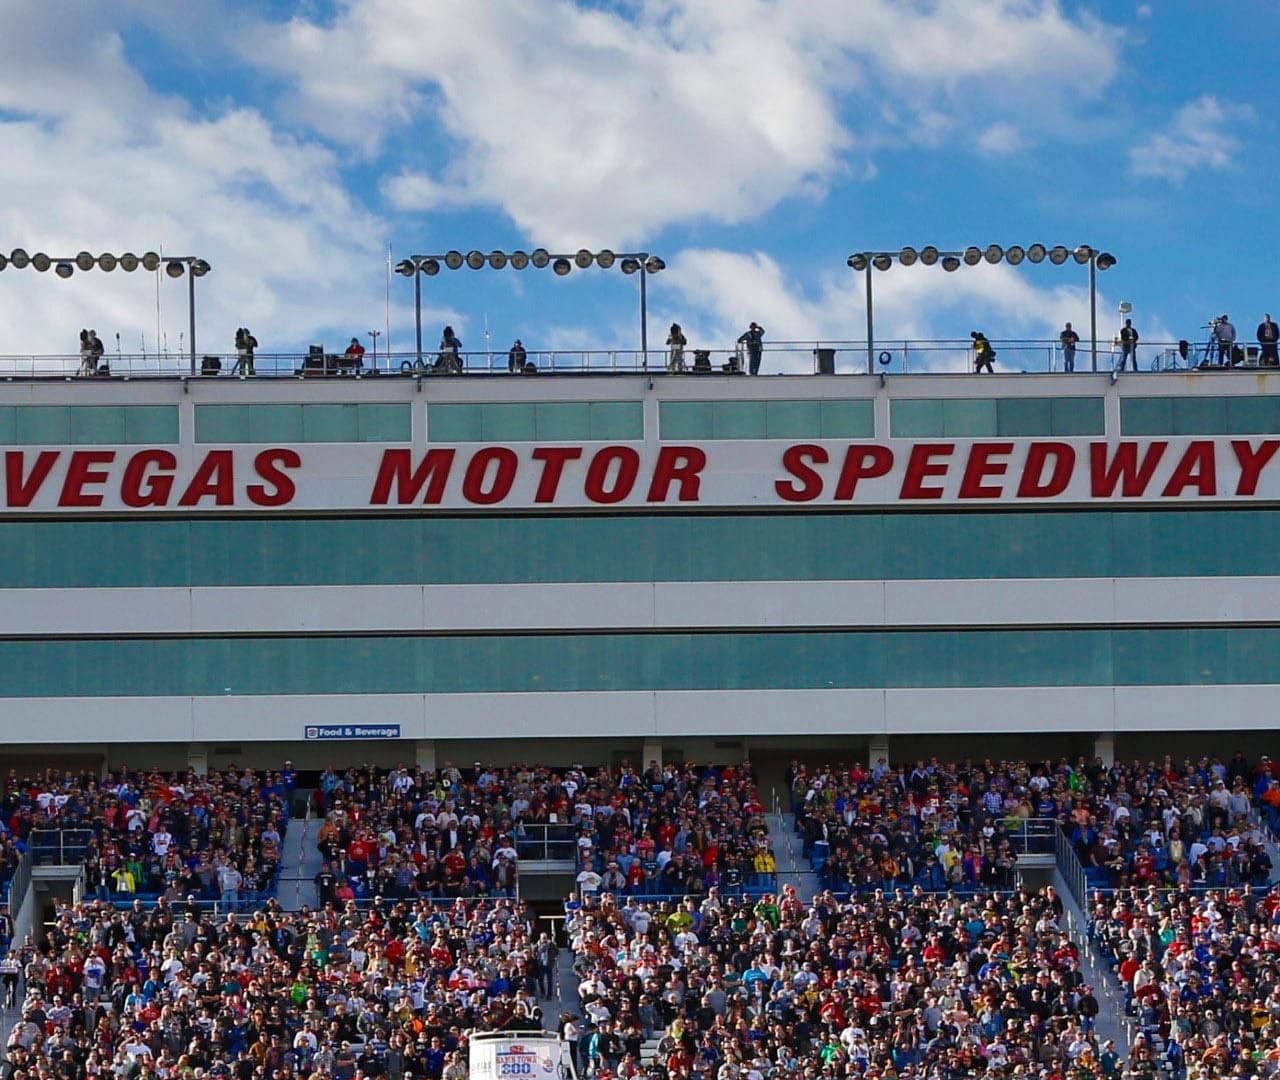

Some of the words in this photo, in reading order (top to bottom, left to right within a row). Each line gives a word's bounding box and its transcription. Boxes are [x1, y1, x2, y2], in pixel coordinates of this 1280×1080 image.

[5, 448, 302, 507] VEGAS
[369, 446, 707, 505] MOTOR
[319, 728, 342, 737] Food
[345, 728, 352, 736] &
[355, 727, 398, 738] Beverage
